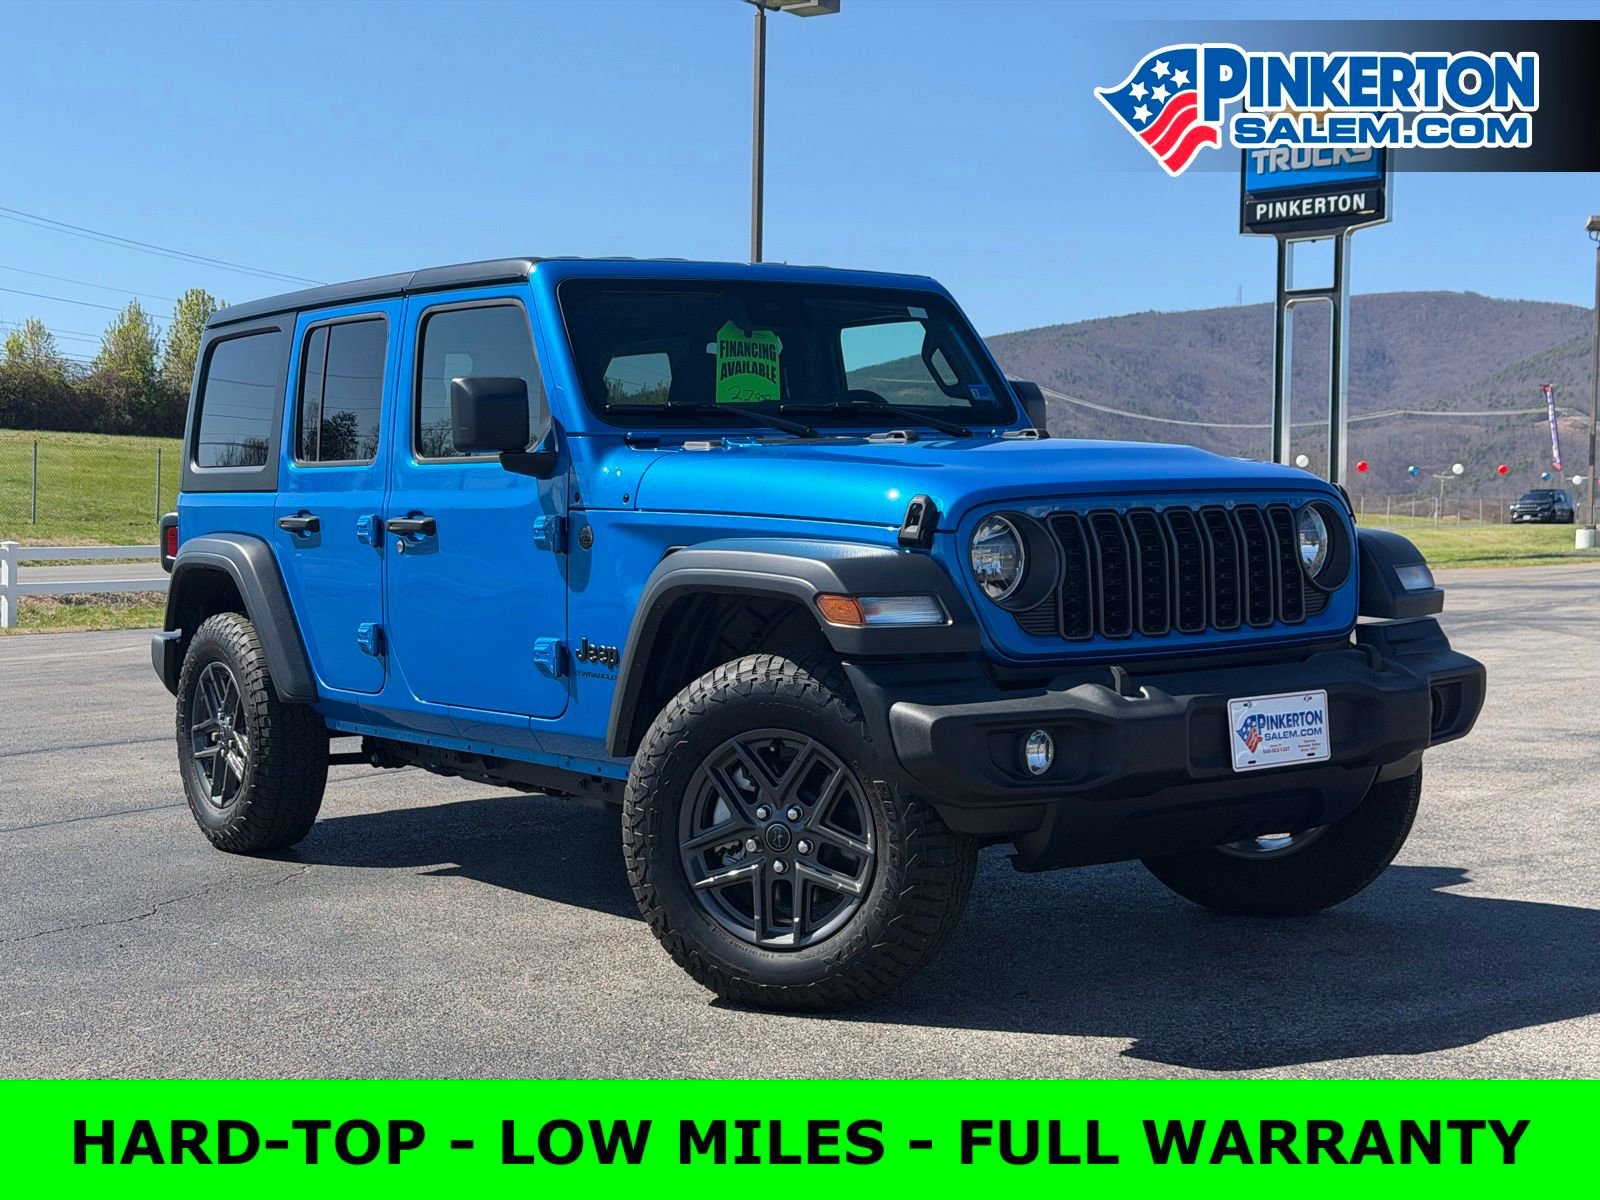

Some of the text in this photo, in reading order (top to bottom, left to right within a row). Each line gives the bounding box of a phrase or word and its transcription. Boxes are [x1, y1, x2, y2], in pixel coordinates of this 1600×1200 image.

[1251, 147, 1372, 175] TRUCKS
[1256, 193, 1366, 221] PINKERTON
[720, 340, 777, 362] FINANCING
[720, 361, 777, 385] AVAILABLE
[575, 637, 619, 671] Jeep
[1257, 710, 1323, 736] PINKERTON
[1264, 727, 1323, 741] SALEM.COM
